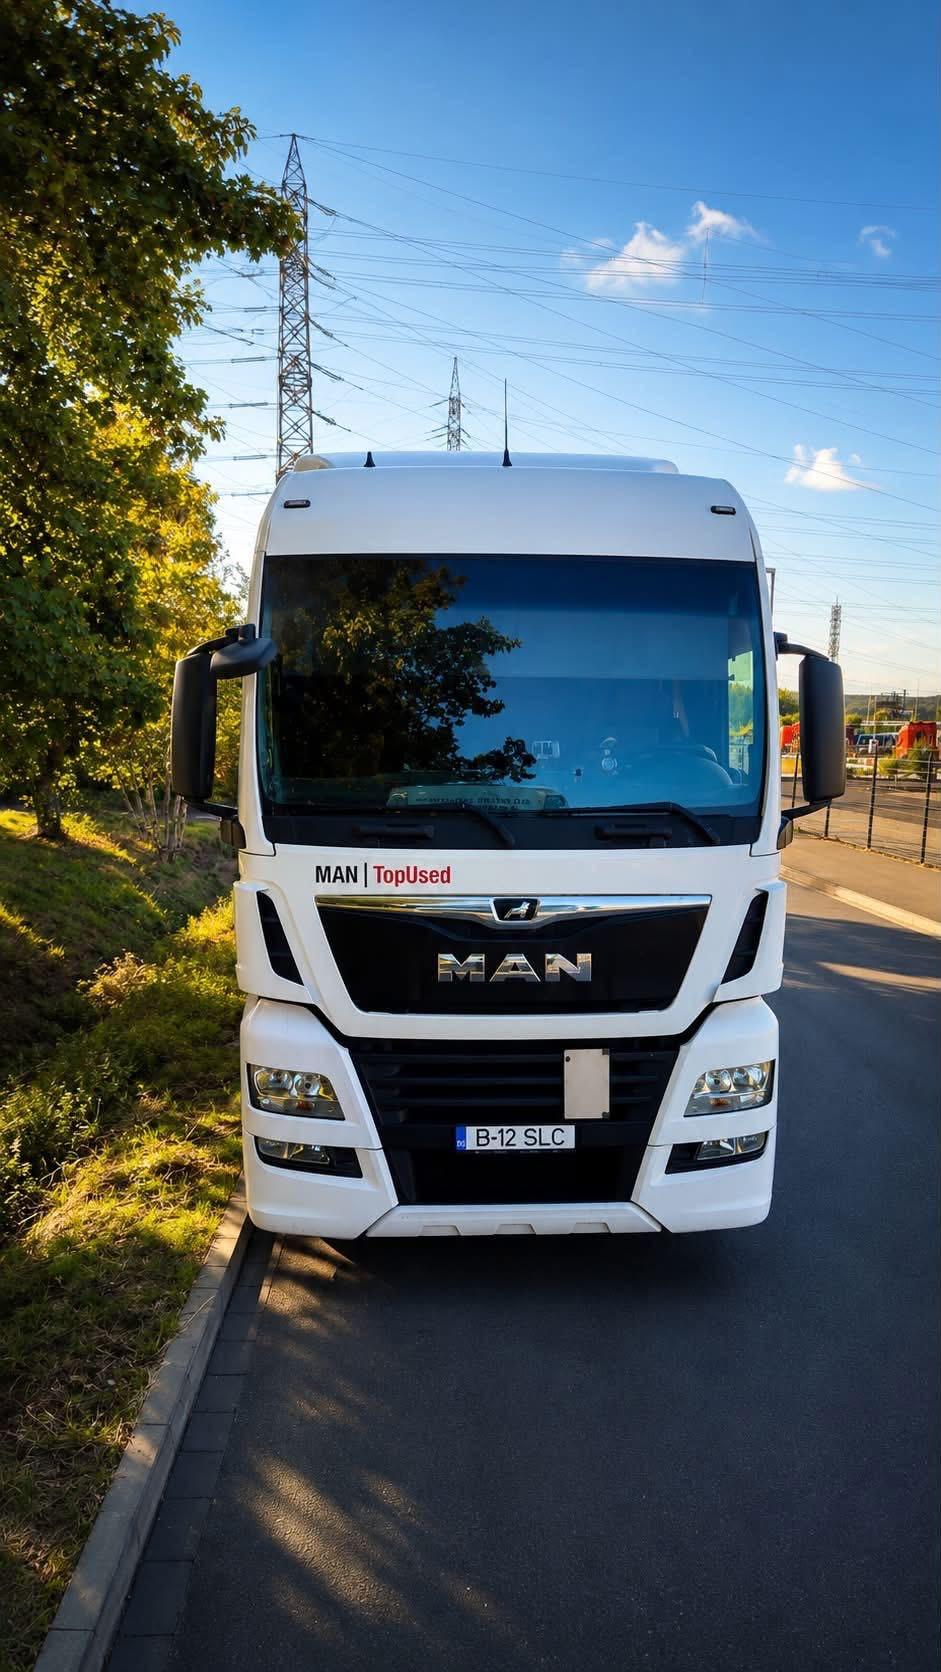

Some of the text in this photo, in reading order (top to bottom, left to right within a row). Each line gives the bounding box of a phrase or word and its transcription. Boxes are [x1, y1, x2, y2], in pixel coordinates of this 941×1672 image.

[315, 865, 451, 887] MAN TopUsed
[437, 953, 592, 982] MAN
[476, 1128, 516, 1147] B-12
[524, 1127, 565, 1146] SLC
